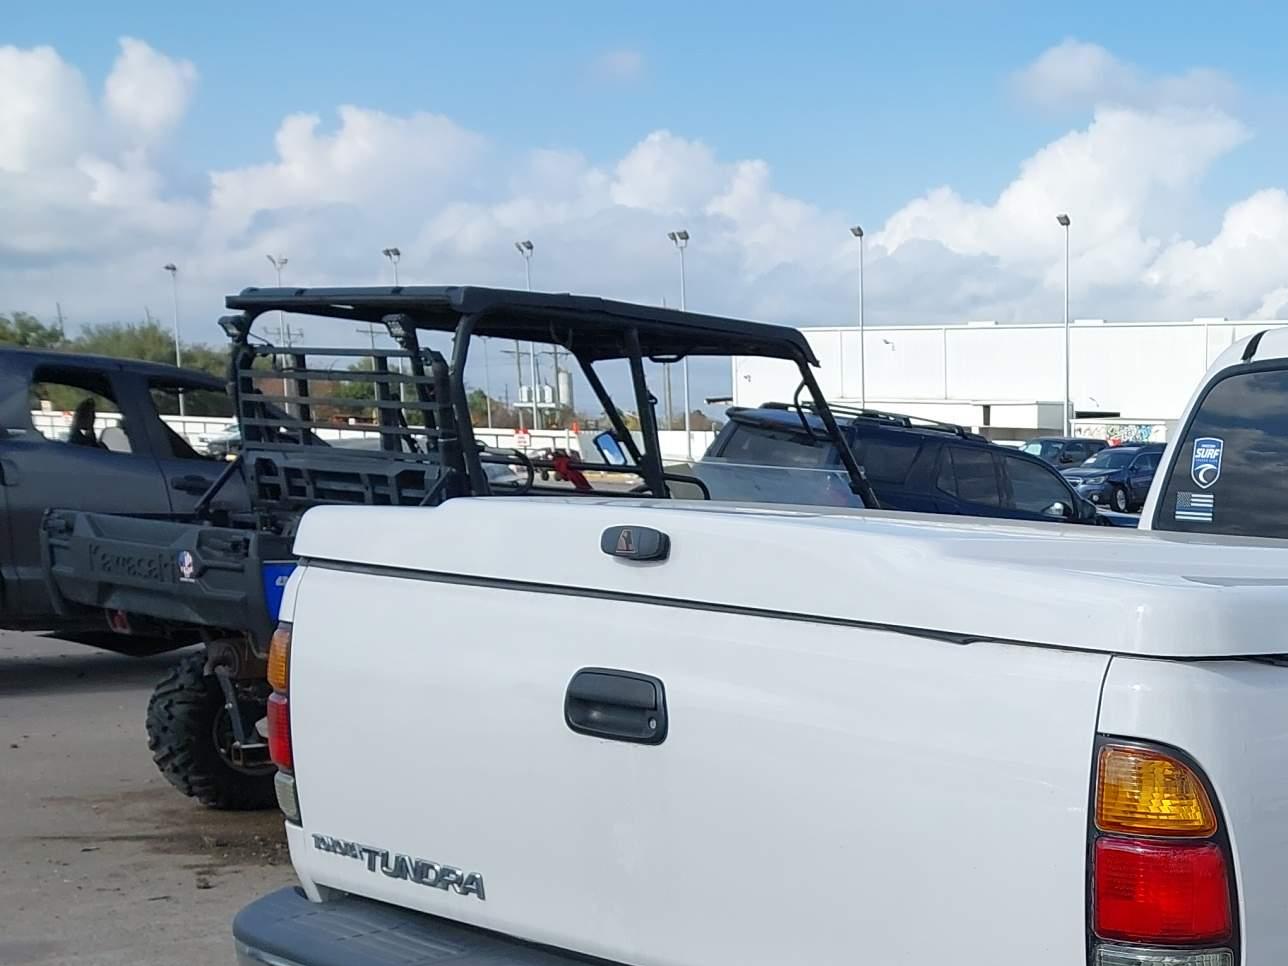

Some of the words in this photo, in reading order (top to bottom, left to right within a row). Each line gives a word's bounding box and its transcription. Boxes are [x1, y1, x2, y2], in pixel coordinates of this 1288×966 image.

[1194, 448, 1220, 458] SURF
[88, 543, 178, 585] Kawasaki
[361, 846, 486, 901] TUNDRA
